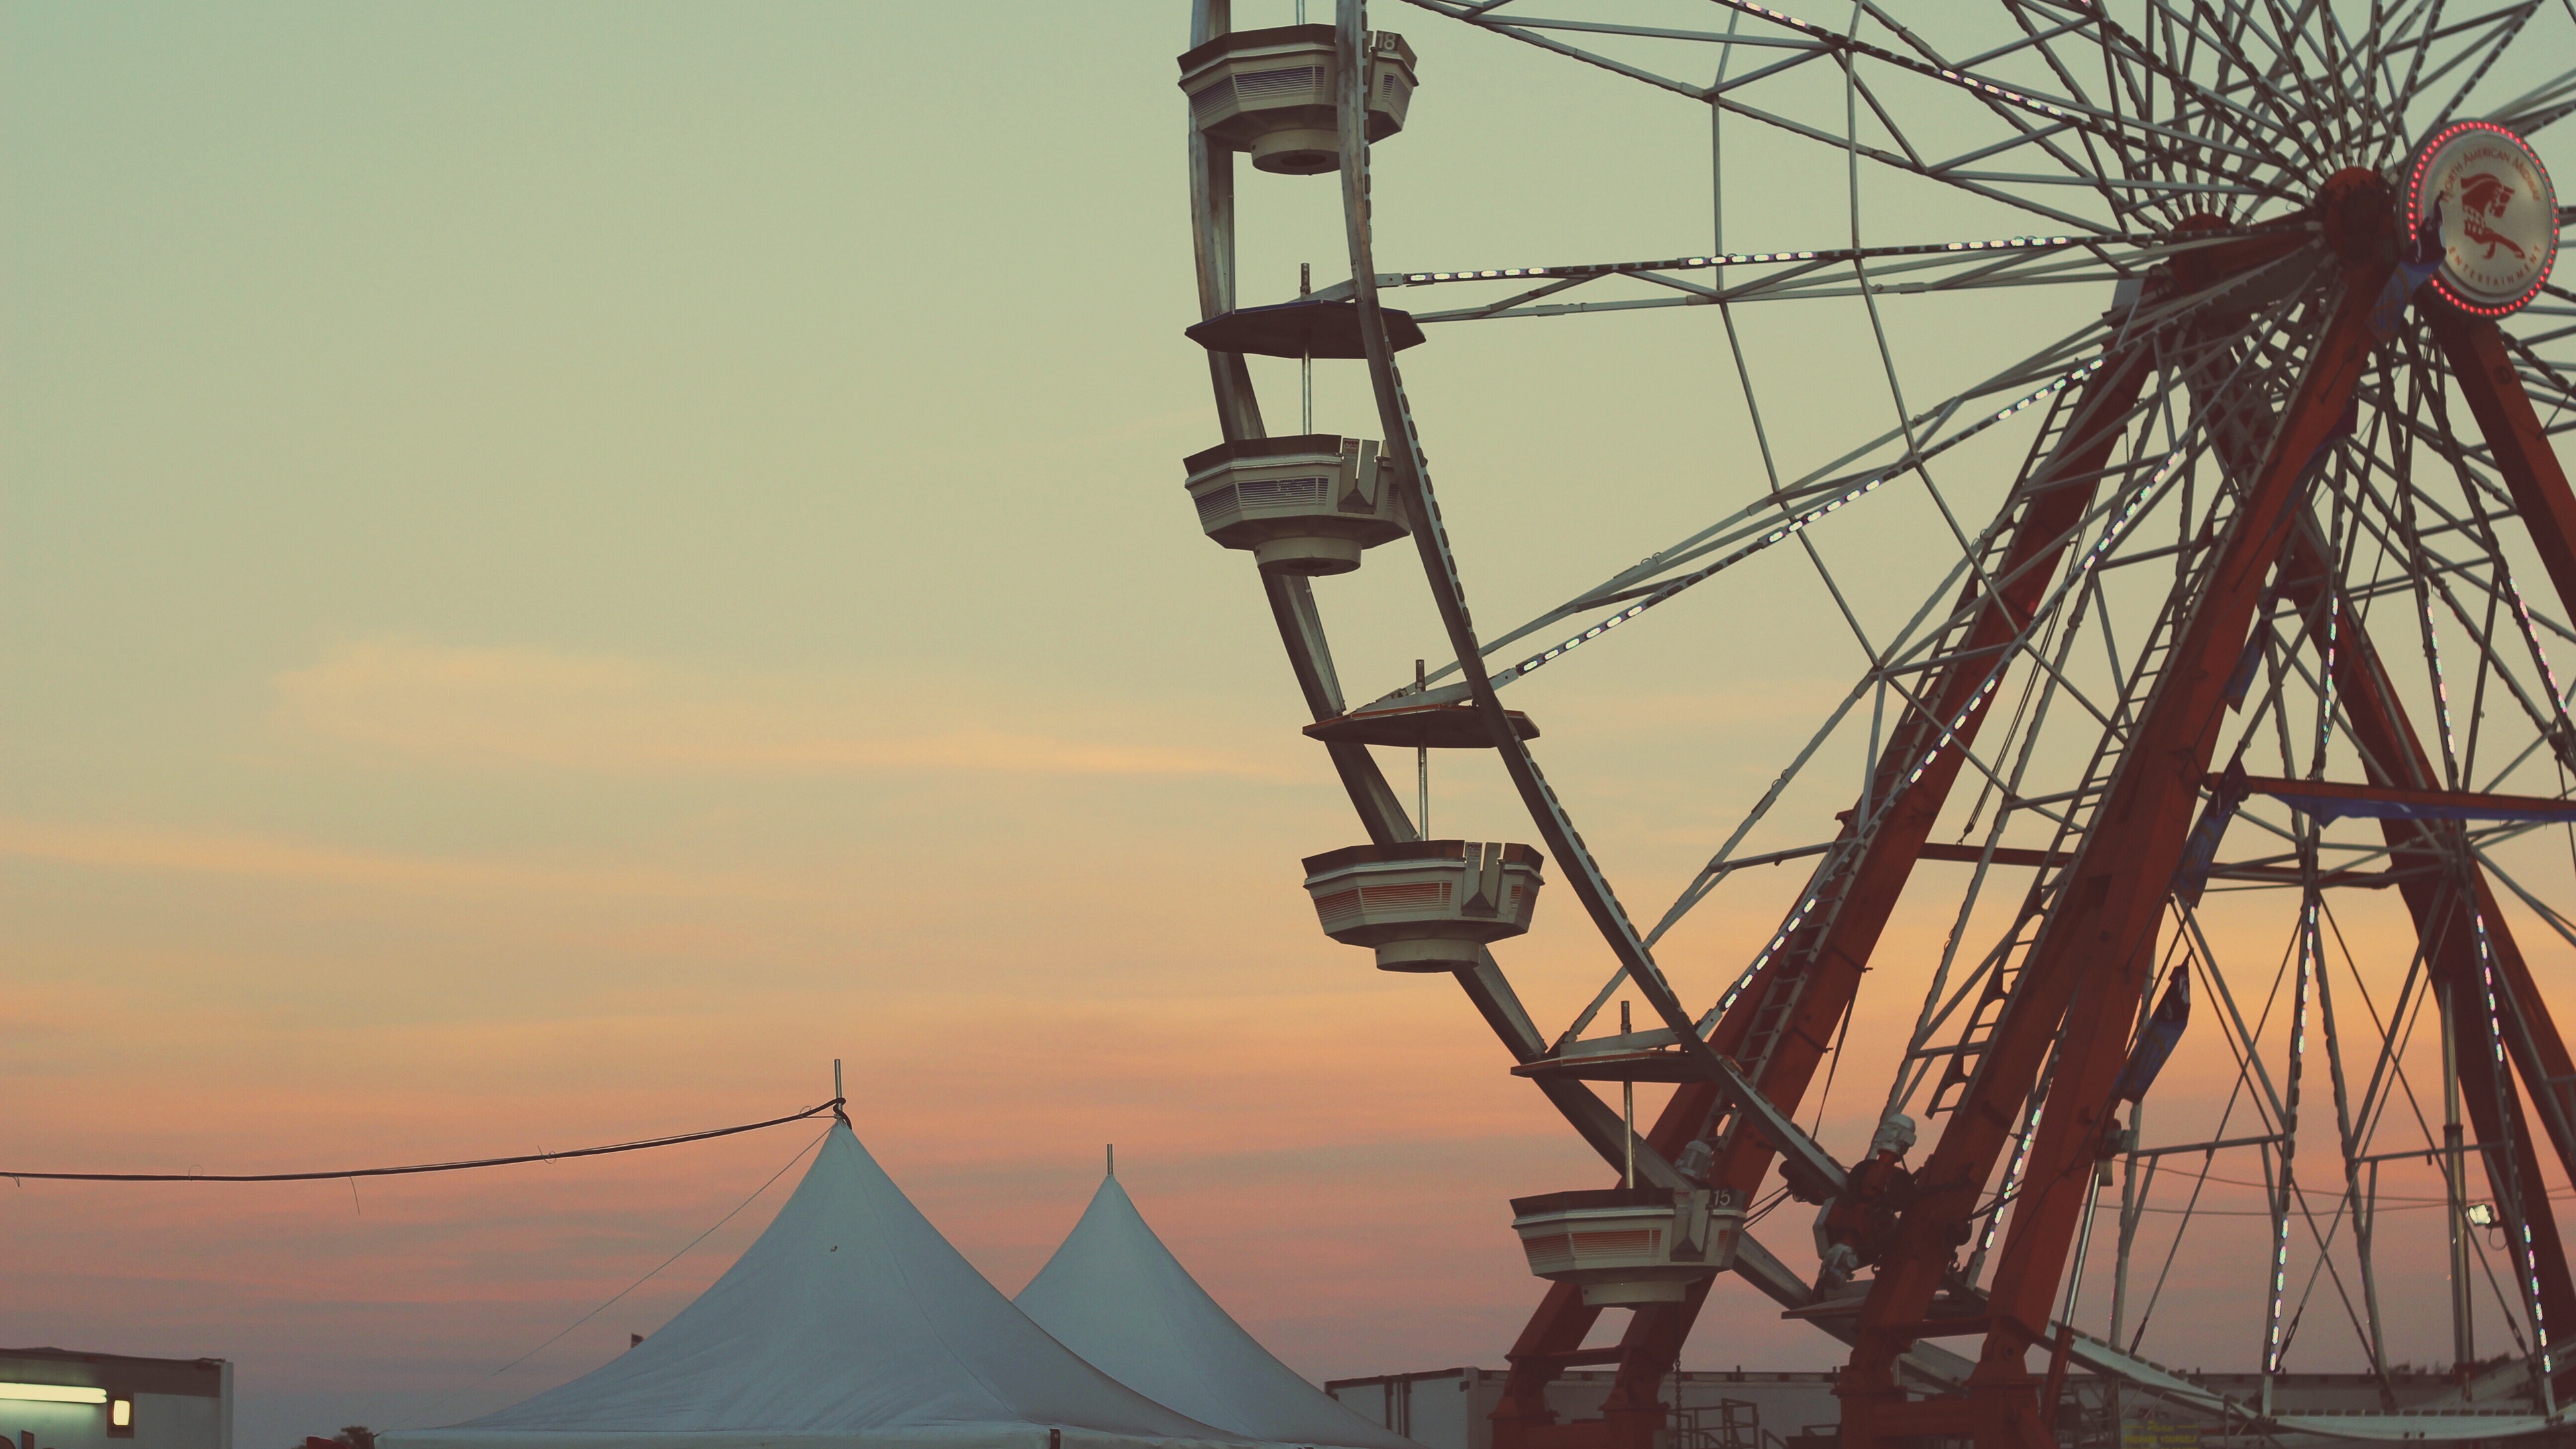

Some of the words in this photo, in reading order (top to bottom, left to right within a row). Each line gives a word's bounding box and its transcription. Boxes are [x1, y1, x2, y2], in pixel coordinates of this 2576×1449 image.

[1377, 32, 1395, 50] 18
[2463, 146, 2510, 166] AMERICAN
[2449, 246, 2540, 287] ENTERTAINMENT
[1713, 1189, 1731, 1206] 15
